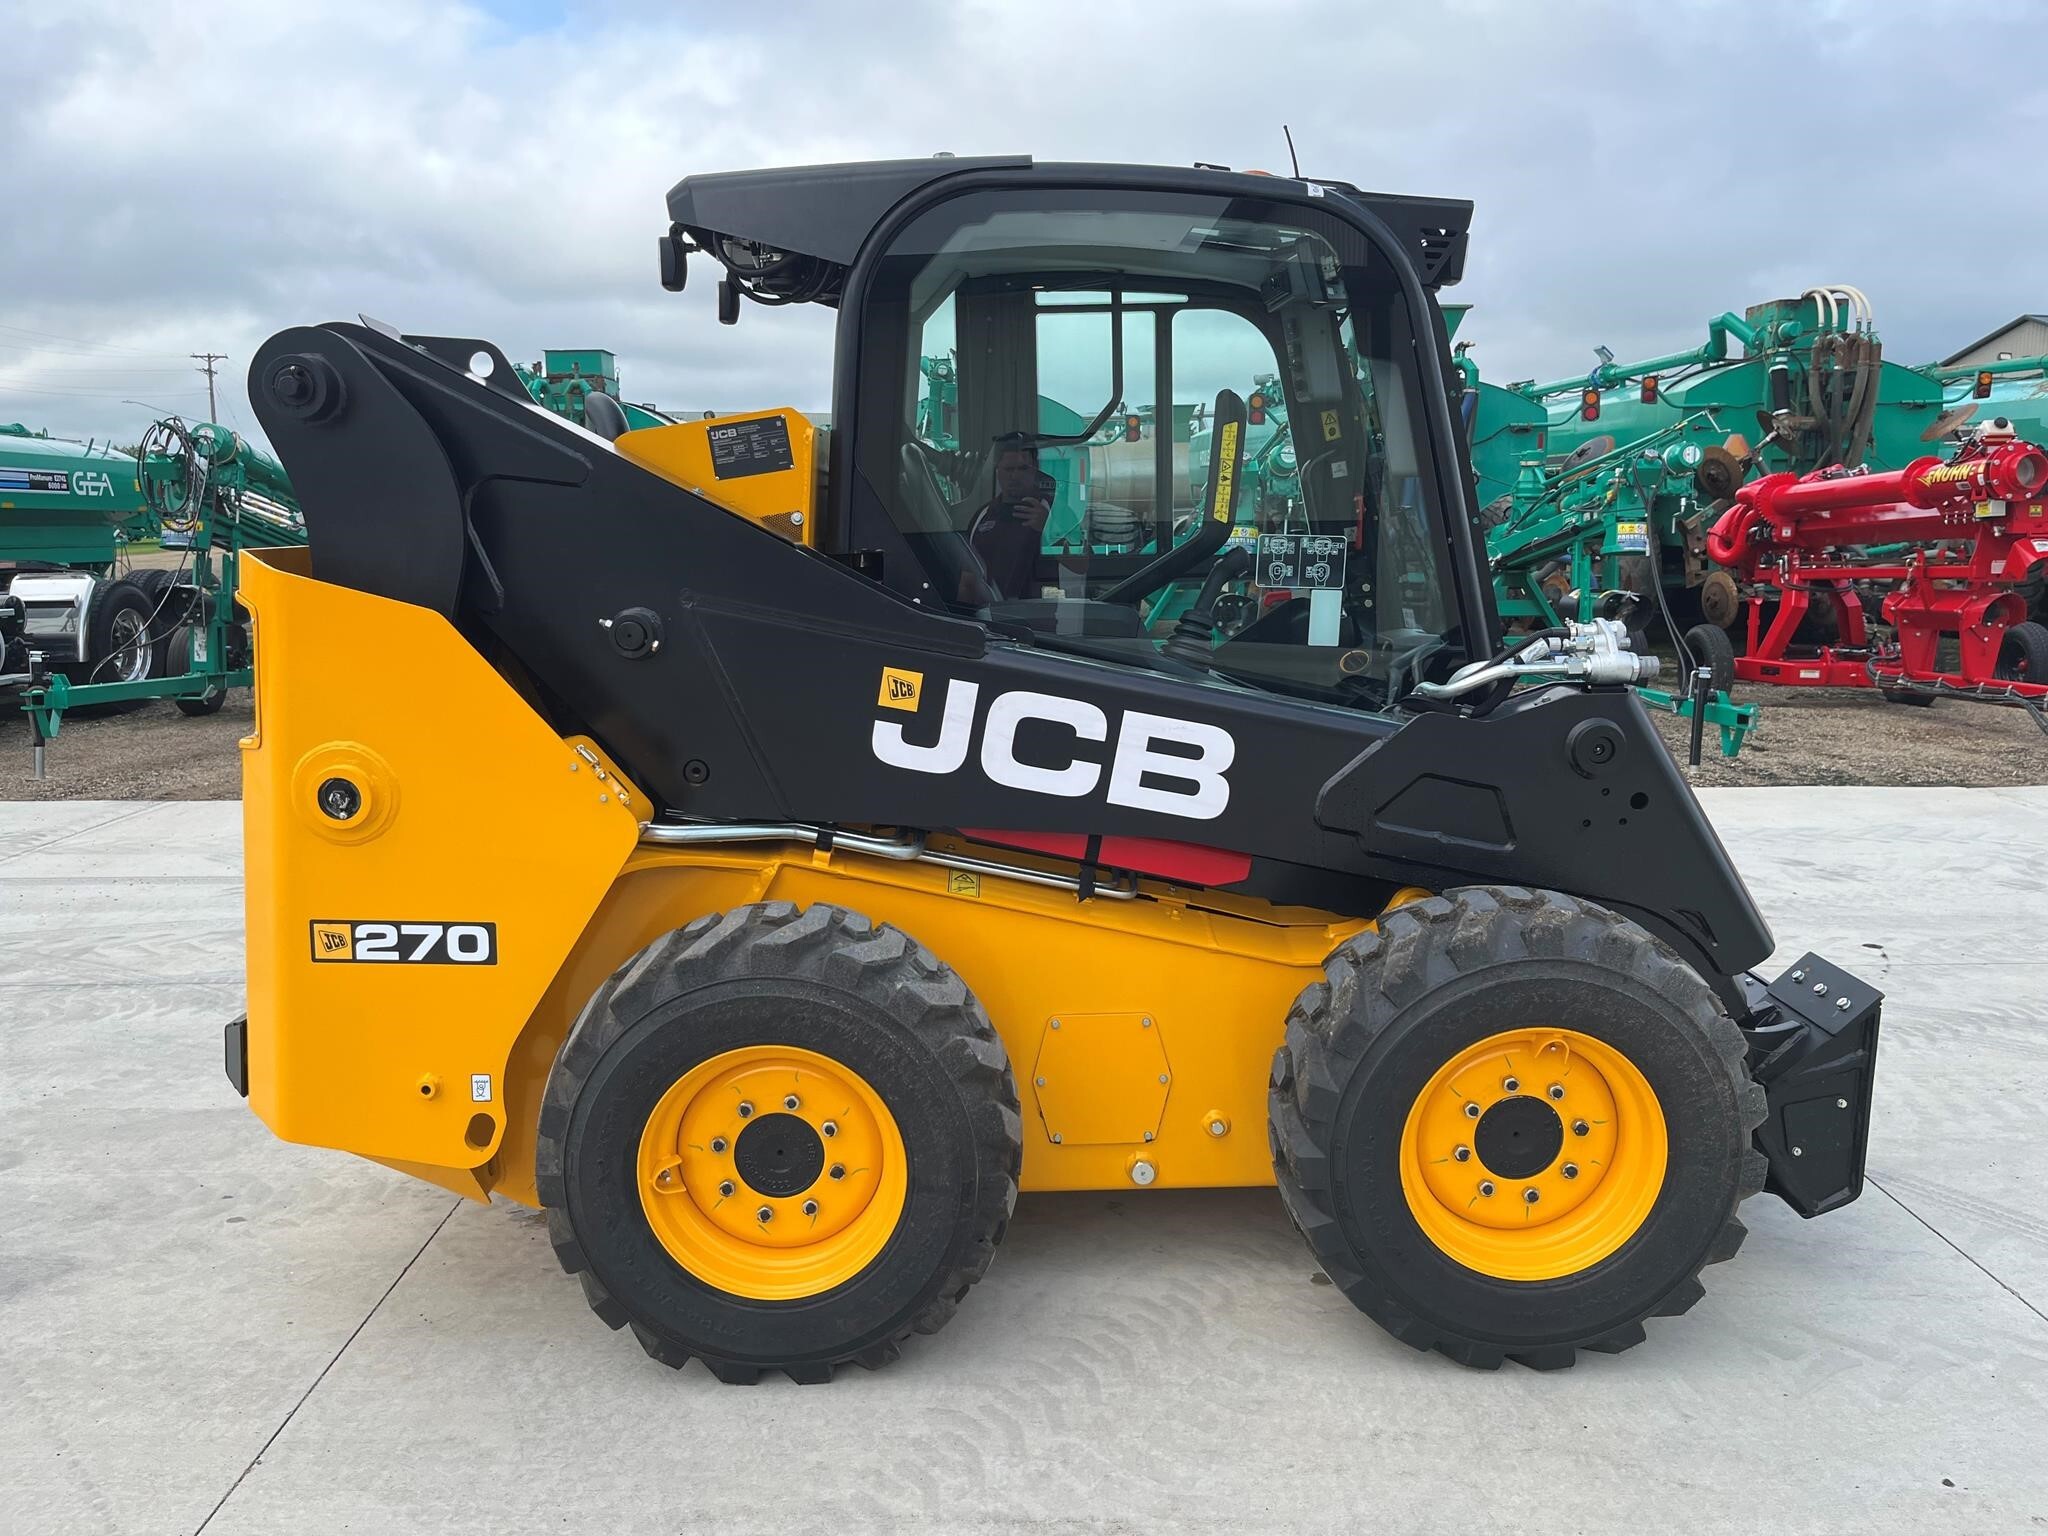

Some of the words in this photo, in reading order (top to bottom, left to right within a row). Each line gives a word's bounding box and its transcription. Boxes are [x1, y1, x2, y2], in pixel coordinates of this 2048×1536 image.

[710, 428, 738, 440] JCB
[72, 471, 114, 497] GEA
[890, 678, 915, 698] JCB
[872, 678, 1236, 820] JCB
[323, 932, 347, 951] JCB
[354, 923, 490, 962] 270
